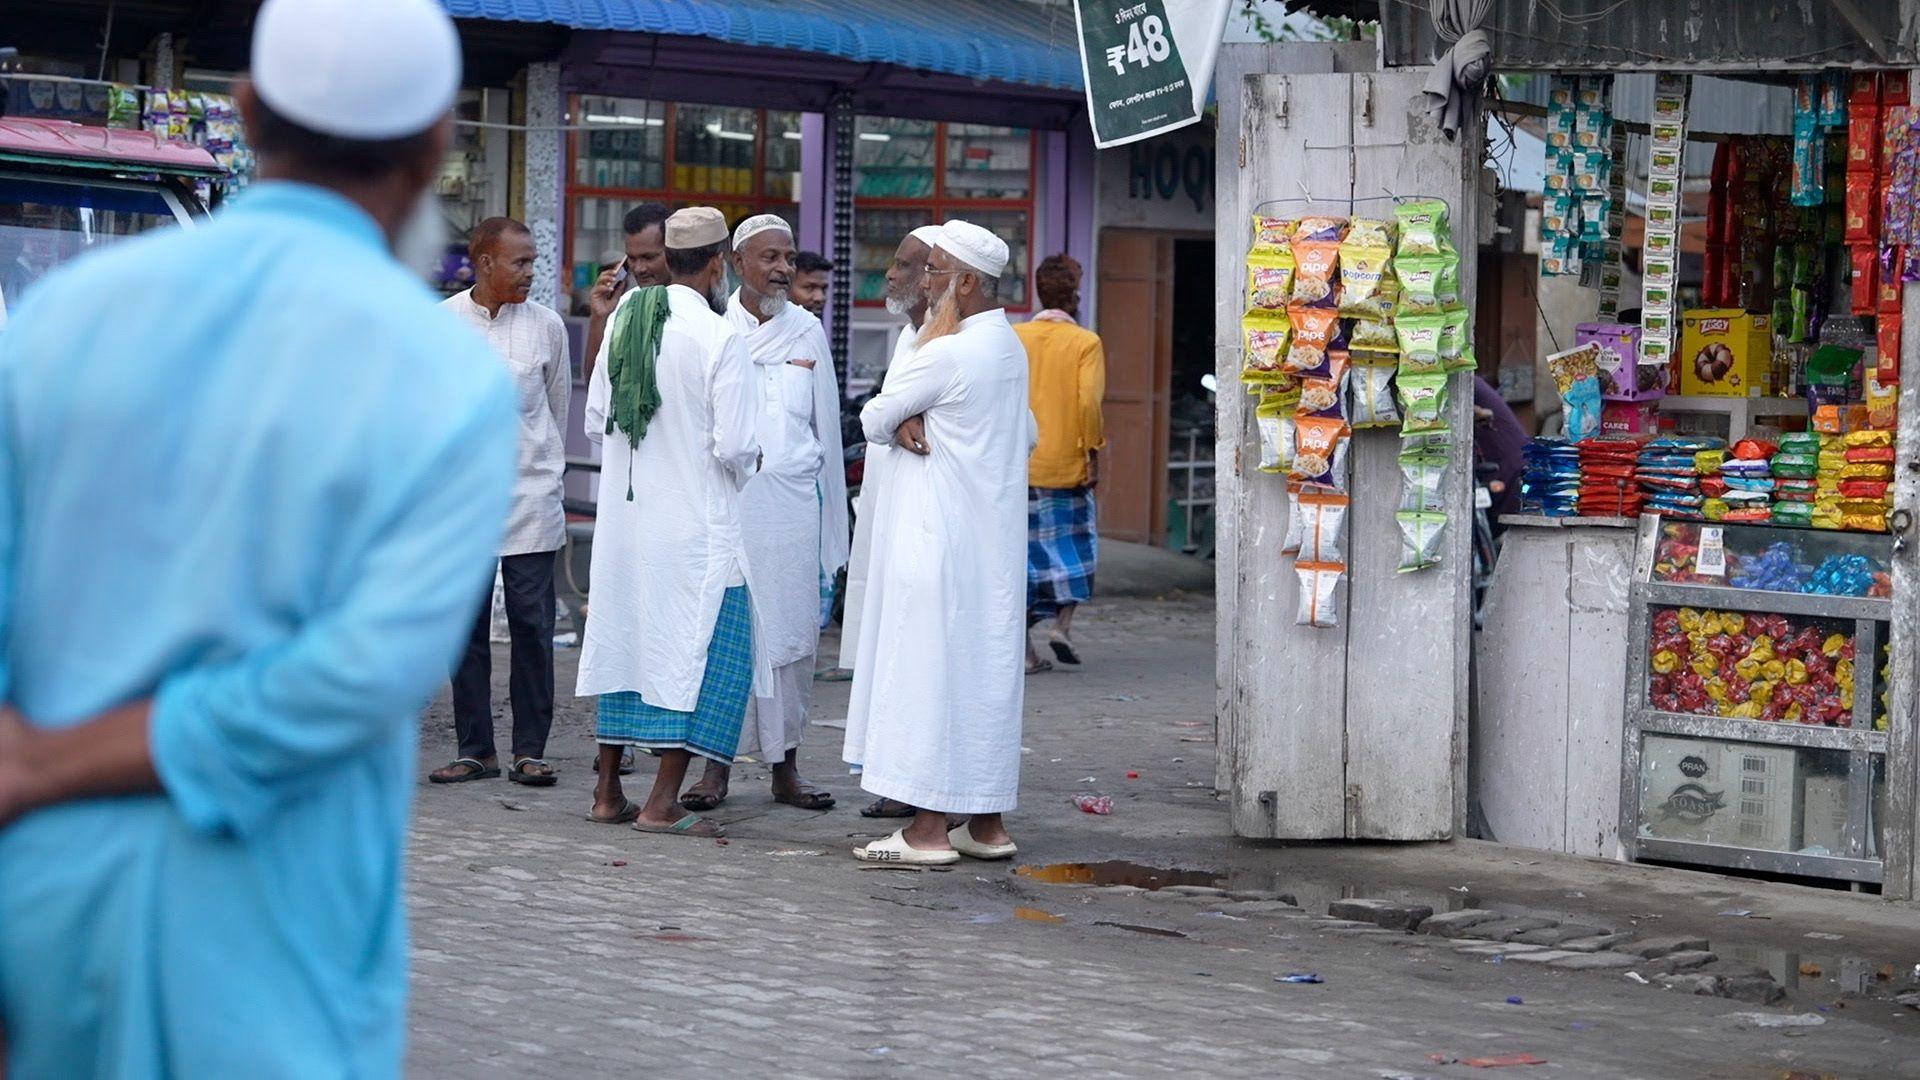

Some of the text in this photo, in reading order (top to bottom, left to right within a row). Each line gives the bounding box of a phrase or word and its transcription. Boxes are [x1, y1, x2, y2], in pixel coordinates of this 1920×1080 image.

[1106, 15, 1170, 76] ₹48
[1301, 262, 1329, 274] pipe
[1298, 330, 1326, 342] pipe
[1681, 762, 1705, 772] PRAN
[878, 850, 890, 861] 23
